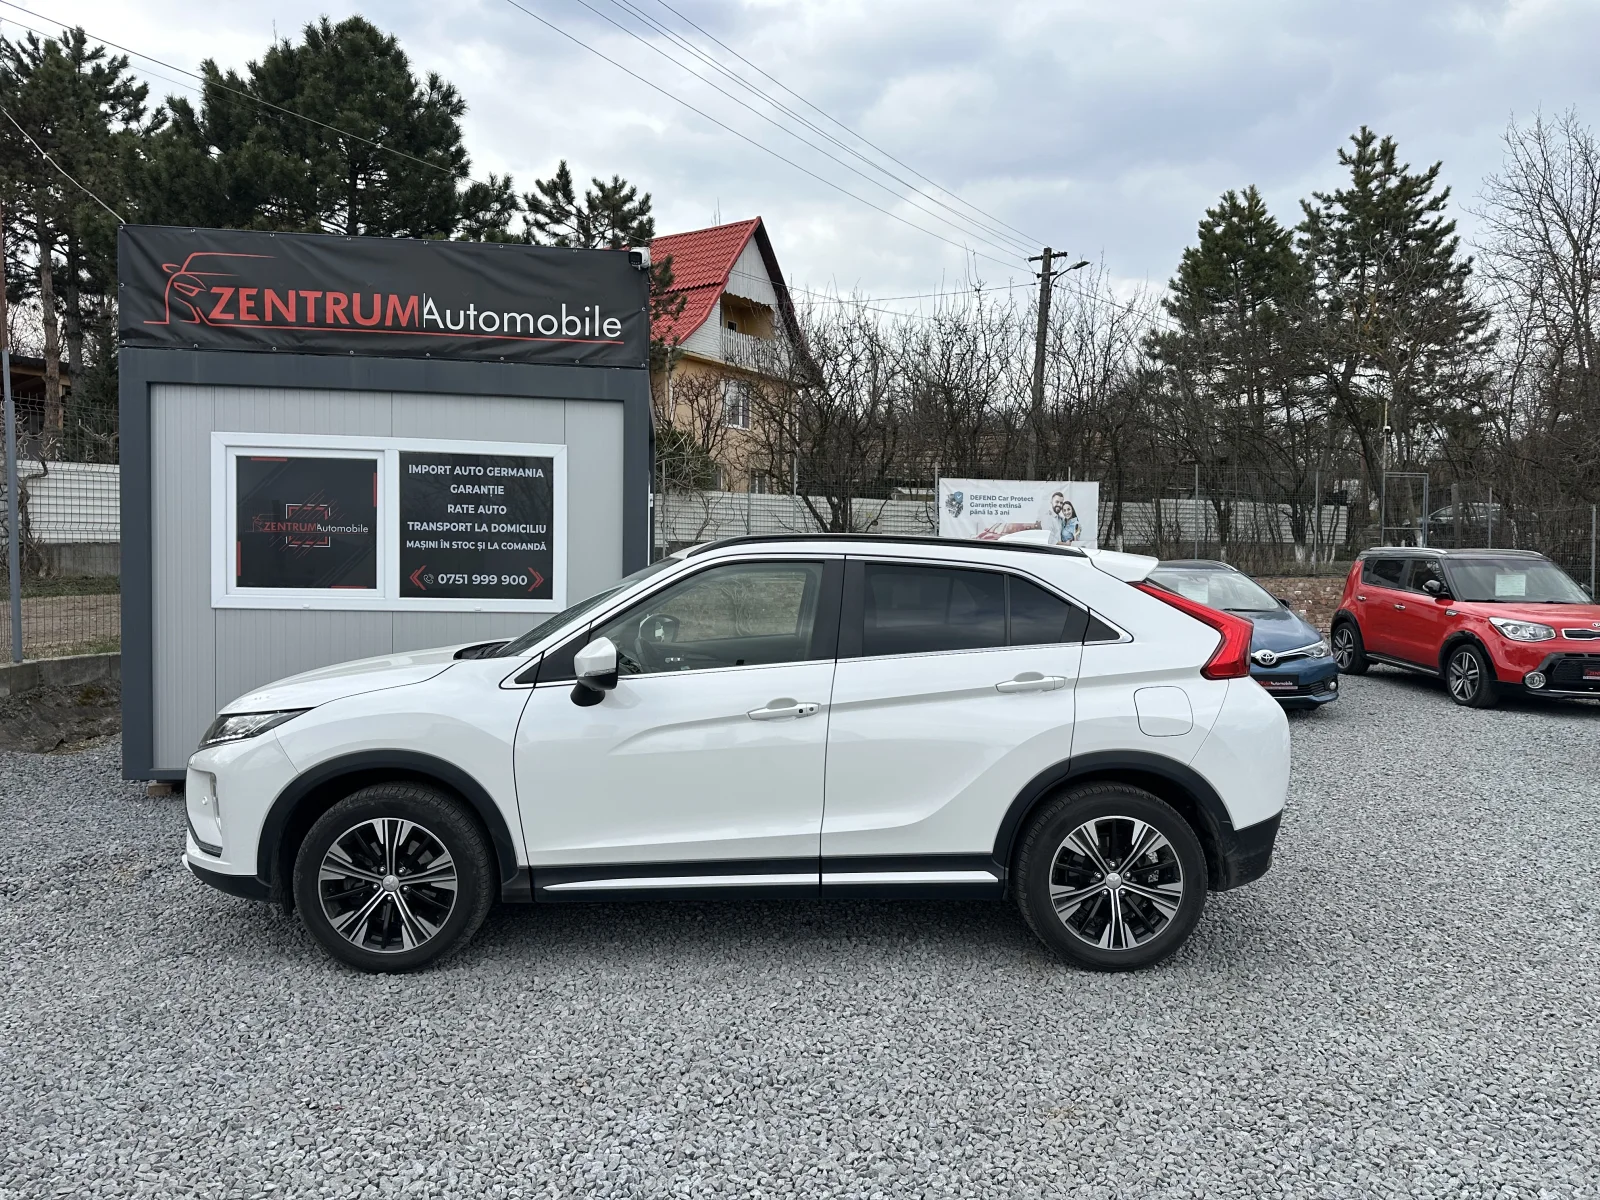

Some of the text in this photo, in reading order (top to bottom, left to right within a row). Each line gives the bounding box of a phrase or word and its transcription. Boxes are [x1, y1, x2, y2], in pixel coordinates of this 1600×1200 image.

[209, 286, 622, 338] ZENTRUM Automobile
[408, 464, 544, 478] IMPORT AUTO GERMANIA
[450, 484, 505, 497] GARANȚIE
[447, 504, 507, 515] RATE AUTO
[264, 522, 369, 533] ZENTRUM Automobile
[407, 521, 547, 534] TRANSPORT LA DOMICILIU
[406, 538, 547, 552] MAȘINI ÎN STOC ȘI LA COMANDĂ
[437, 573, 528, 586] 0751 999 900
